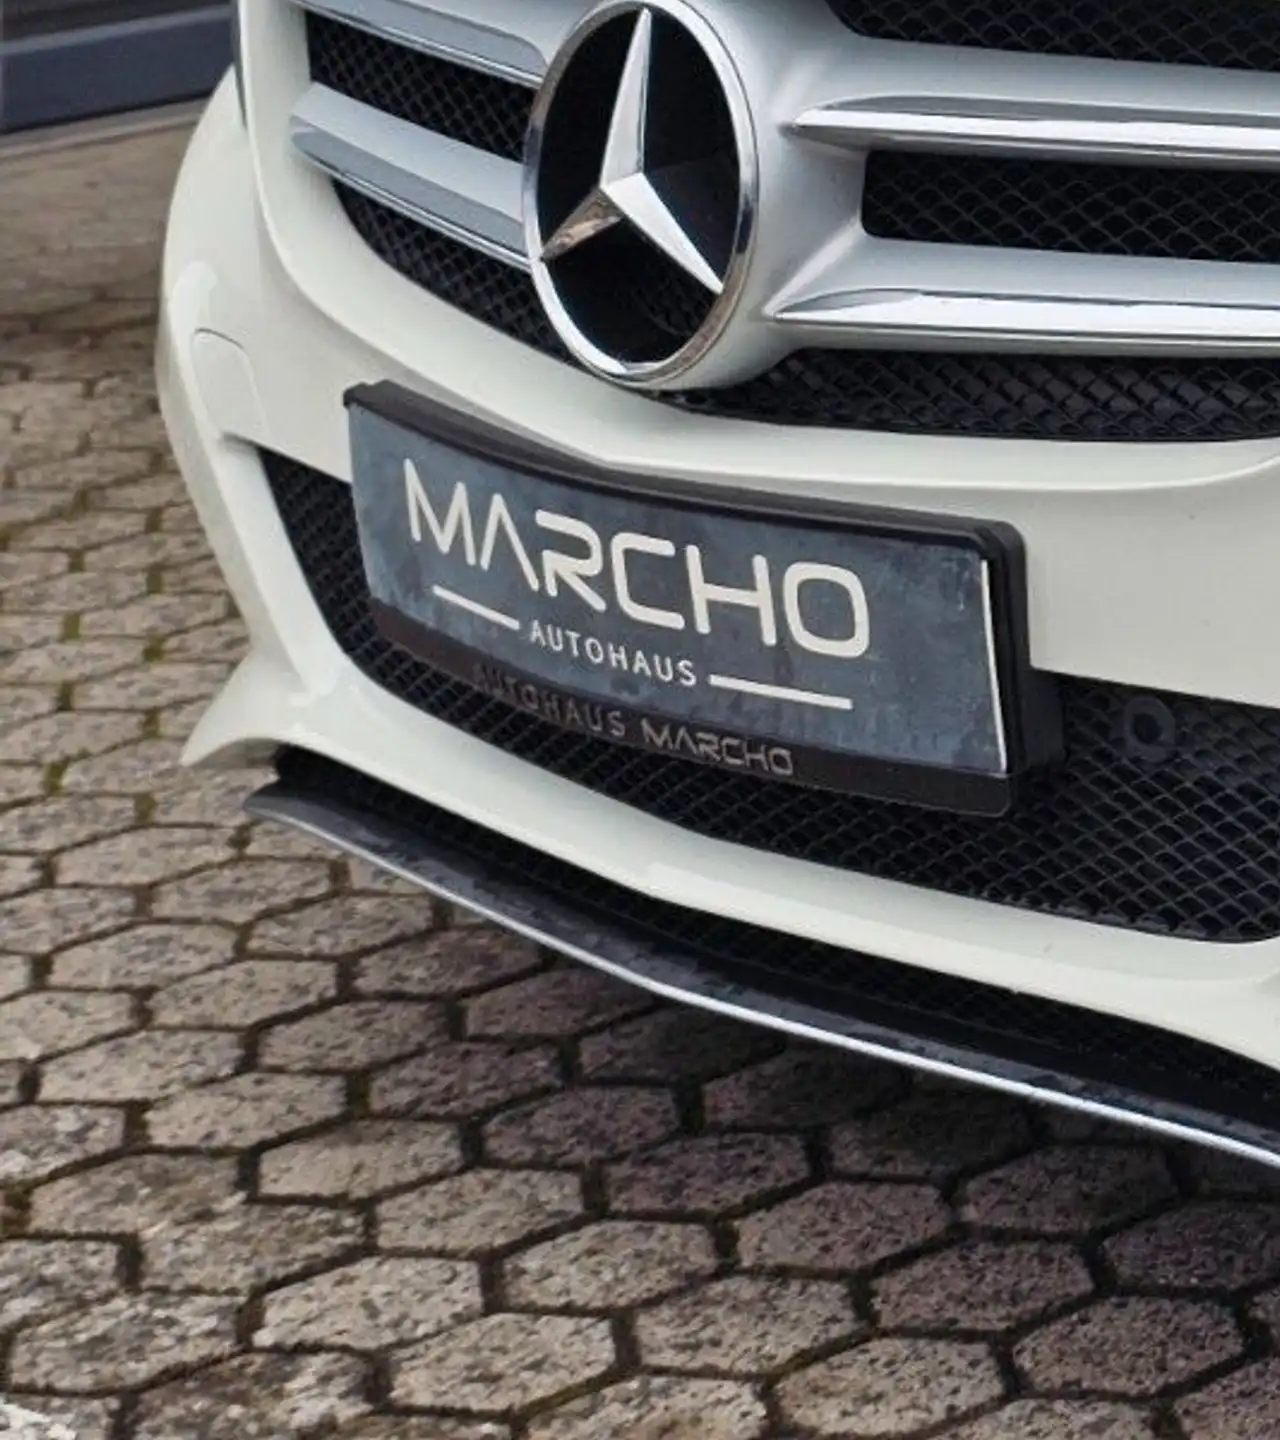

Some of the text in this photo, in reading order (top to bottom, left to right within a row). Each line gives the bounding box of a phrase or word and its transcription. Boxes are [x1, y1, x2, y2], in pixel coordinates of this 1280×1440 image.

[403, 458, 870, 658] MARCHO
[530, 620, 697, 687] AUTOHAUS
[472, 662, 794, 776] AUTOHAUS MARCHO
